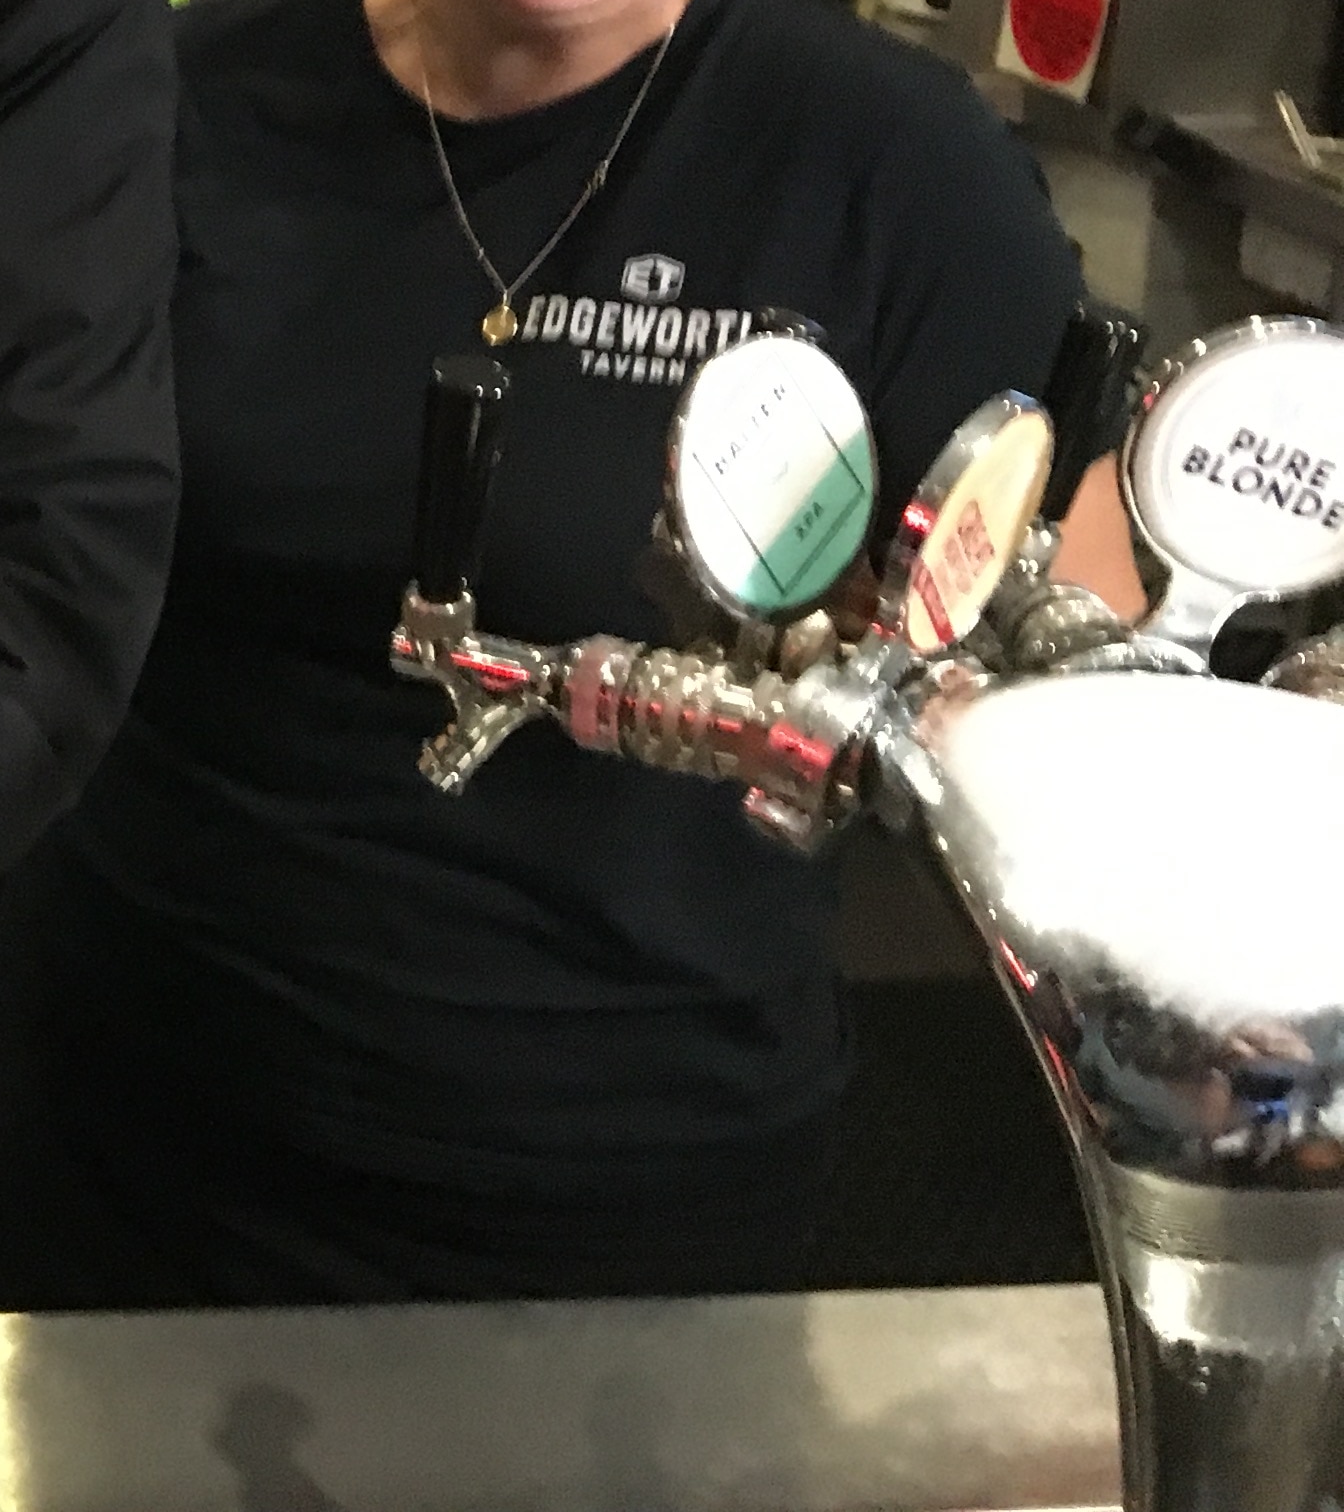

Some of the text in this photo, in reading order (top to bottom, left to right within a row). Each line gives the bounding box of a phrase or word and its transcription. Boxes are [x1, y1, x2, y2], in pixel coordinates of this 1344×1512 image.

[580, 348, 687, 387] TAVERN
[1180, 444, 1344, 533] BLONDE
[1228, 426, 1337, 490] PURE
